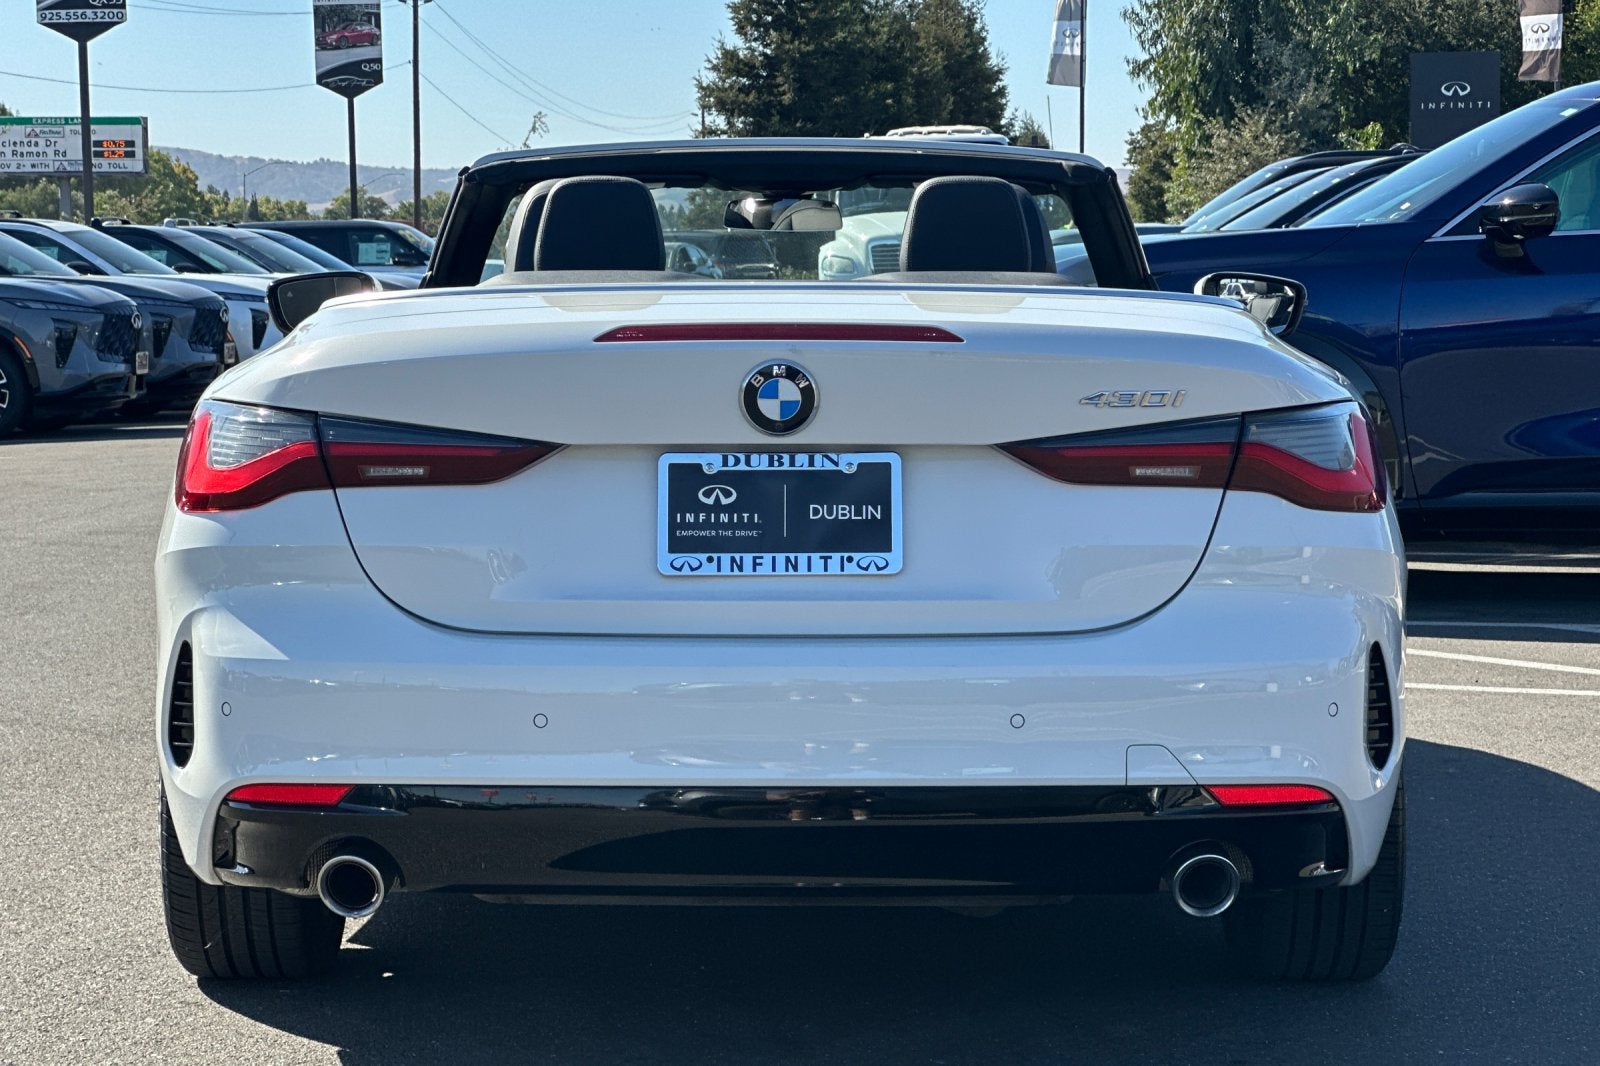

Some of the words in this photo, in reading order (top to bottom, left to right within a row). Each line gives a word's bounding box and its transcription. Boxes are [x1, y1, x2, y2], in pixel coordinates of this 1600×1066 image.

[40, 11, 124, 21] 925.556.3200
[361, 62, 381, 72] Q50
[1421, 101, 1491, 110] INFINITI
[45, 139, 58, 147] Dr
[11, 150, 48, 158] Ramon
[53, 150, 67, 158] Rd
[30, 162, 50, 170] WITH
[107, 162, 128, 170] TOLL
[750, 365, 810, 389] BMW
[719, 453, 841, 468] DUBLIN
[809, 504, 882, 520] DUBLIN
[676, 512, 759, 523] INFINITI
[716, 555, 846, 573] INFINITI
